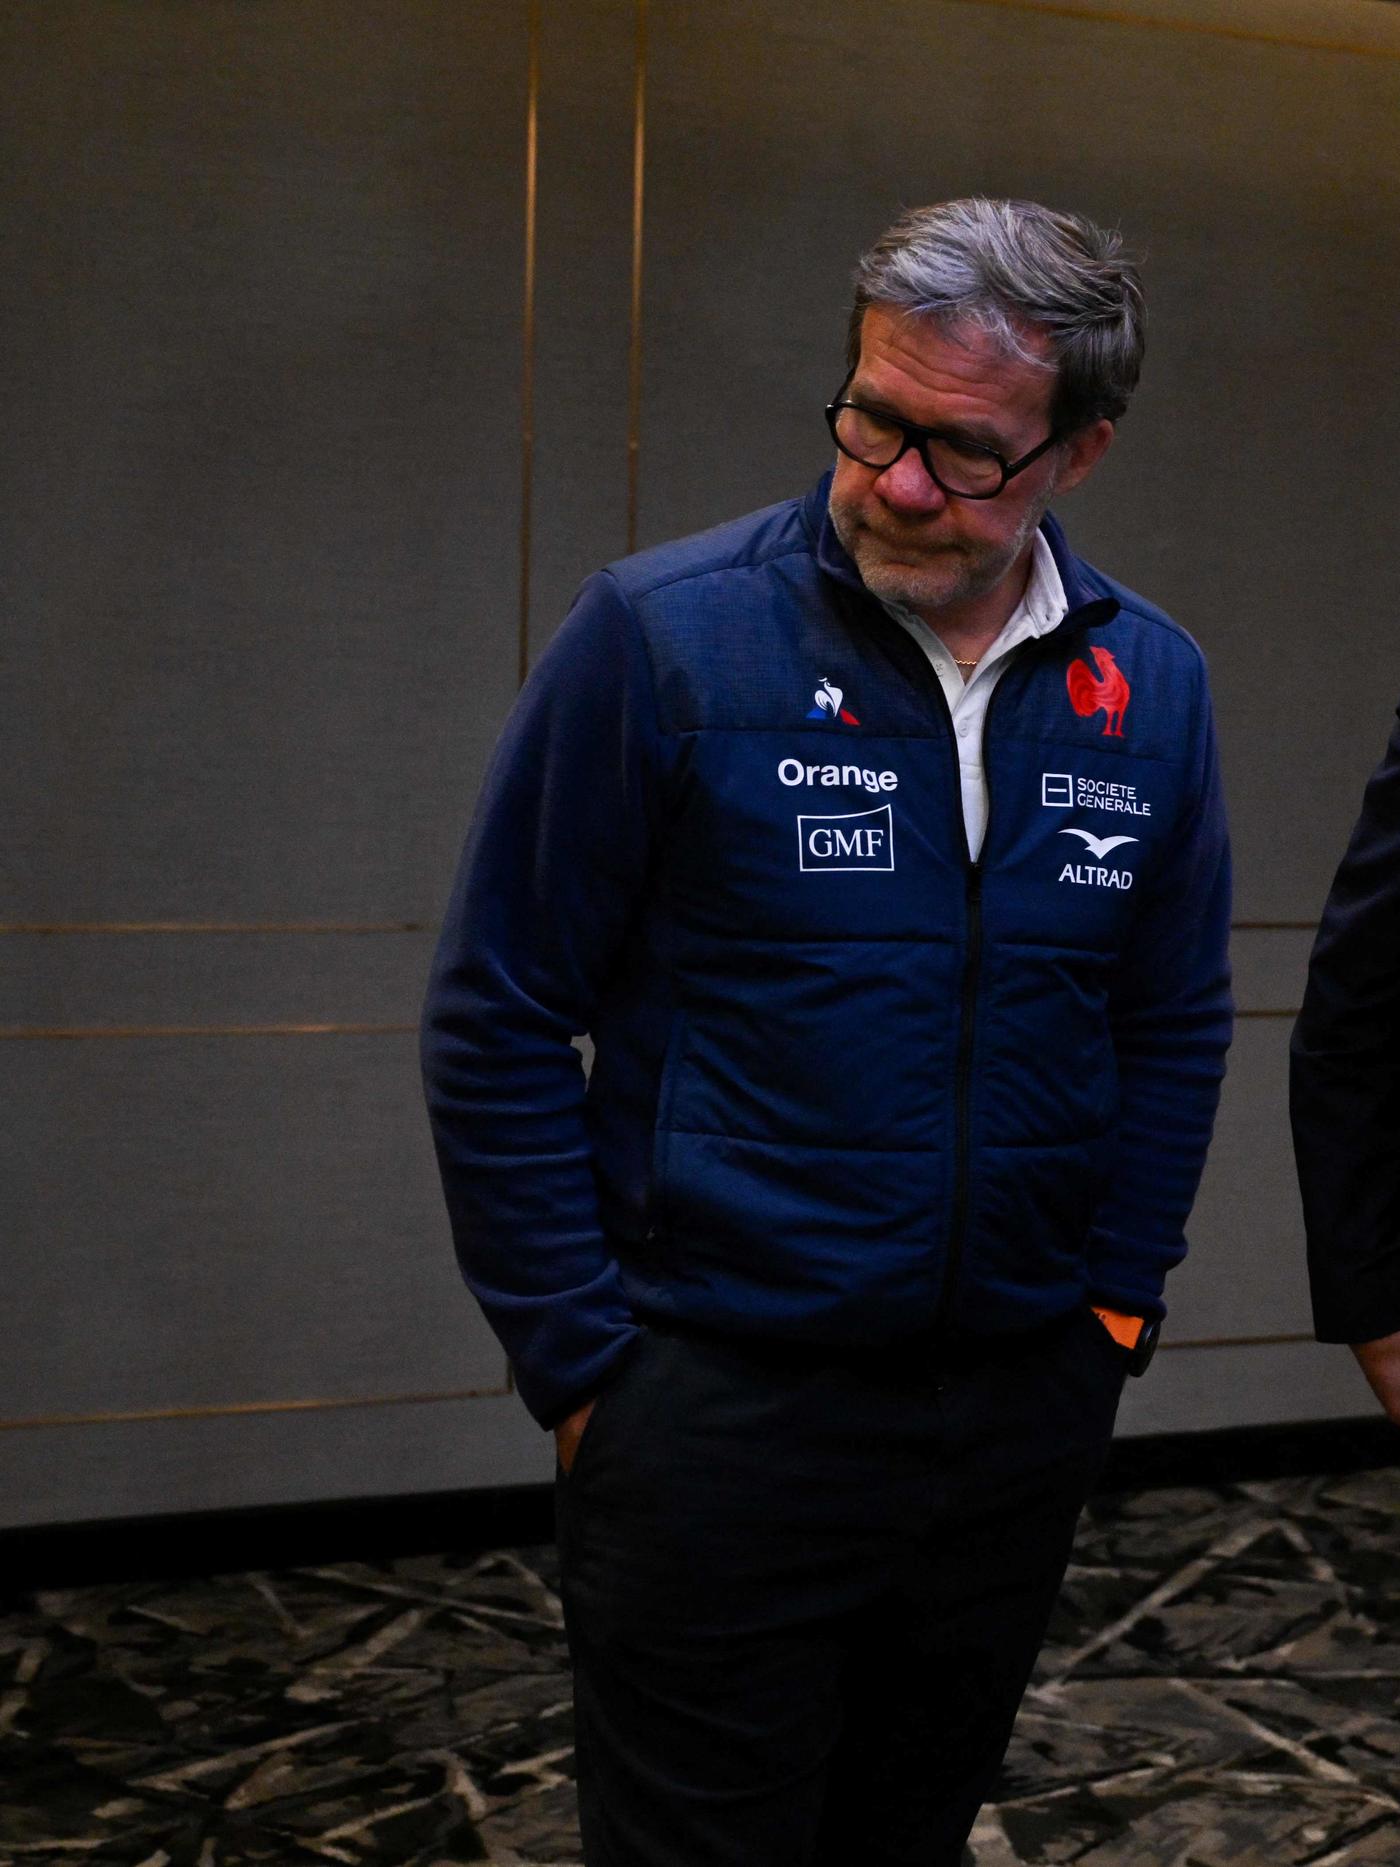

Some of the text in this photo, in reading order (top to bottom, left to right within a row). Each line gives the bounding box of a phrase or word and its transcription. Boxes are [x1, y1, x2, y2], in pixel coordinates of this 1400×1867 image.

[777, 758, 899, 793] Orange
[1077, 777, 1137, 800] SOCIETE
[1076, 793, 1152, 817] GENERALE
[808, 829, 884, 858] GMF
[1058, 863, 1133, 890] ALTRAD
